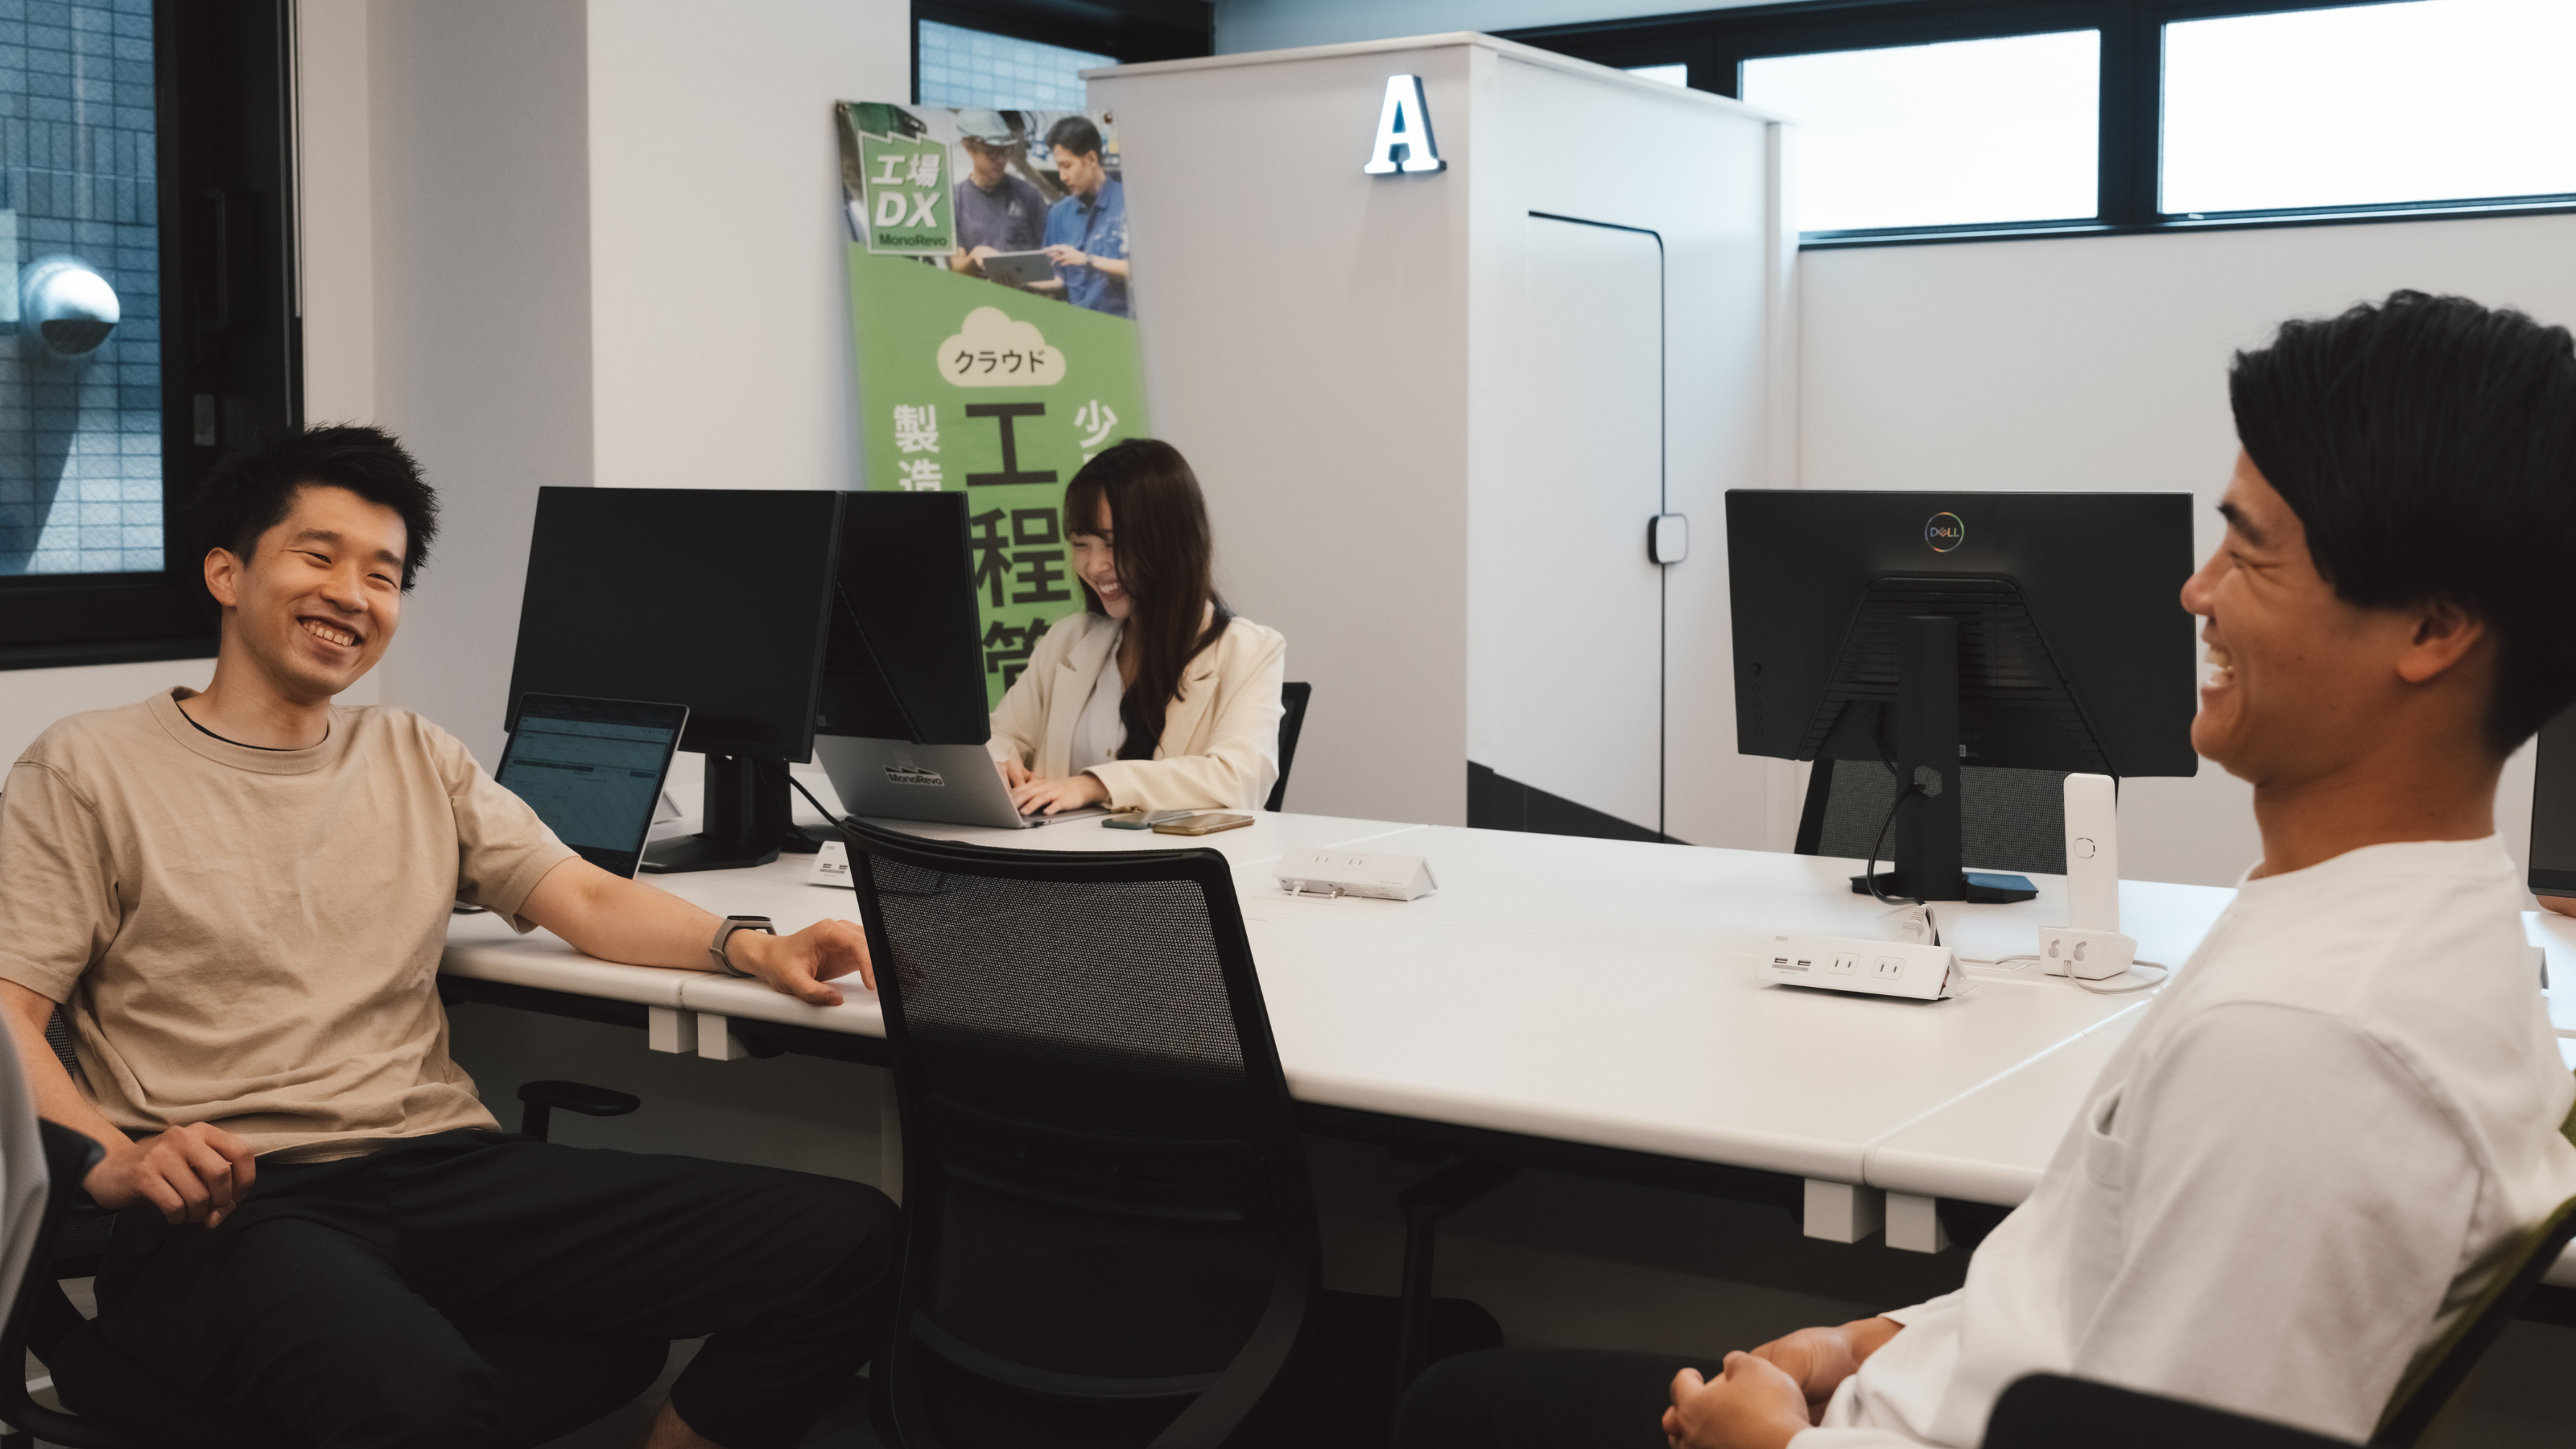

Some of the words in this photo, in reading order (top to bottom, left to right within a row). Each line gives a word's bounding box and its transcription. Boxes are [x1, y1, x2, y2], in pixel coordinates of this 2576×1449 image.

[1364, 74, 1443, 175] A
[871, 154, 939, 188] 工場
[875, 192, 941, 228] DX
[879, 234, 947, 246] MonoRevo
[955, 350, 1045, 374] クラウド
[1074, 399, 1117, 464] 少
[1930, 527, 1960, 537] DELL
[888, 774, 943, 785] MonoRevo
